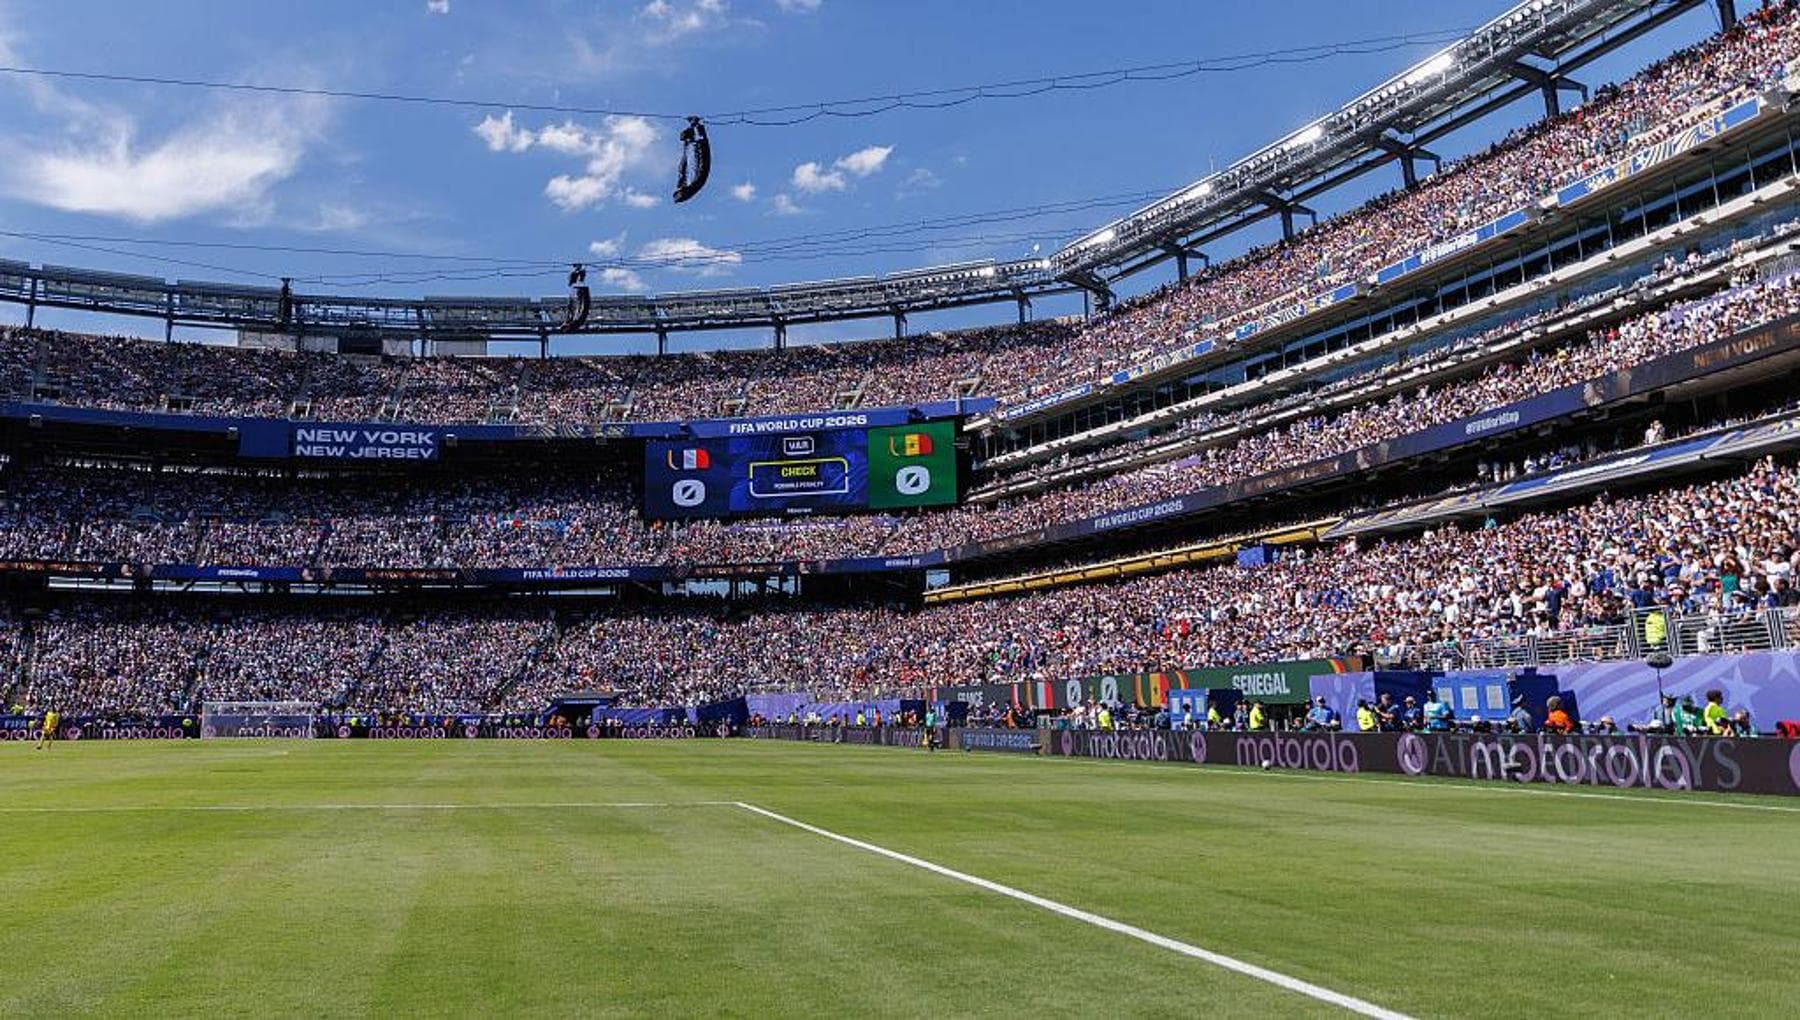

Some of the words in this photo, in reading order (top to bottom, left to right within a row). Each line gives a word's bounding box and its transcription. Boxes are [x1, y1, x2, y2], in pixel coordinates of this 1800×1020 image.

[730, 423, 754, 434] FIFA
[756, 419, 798, 432] WORLD
[800, 418, 823, 429] CUP
[825, 414, 867, 427] 2026
[296, 429, 357, 443] NEW
[363, 431, 433, 444] YORK
[296, 445, 345, 457] NEW
[350, 447, 433, 459] JERSEY
[789, 440, 809, 450] VAR
[781, 466, 817, 477] CHECK
[896, 466, 930, 495] 0
[672, 480, 705, 507] 0
[1155, 500, 1184, 516] 2026
[1233, 672, 1290, 696] SENEGAL
[103, 725, 184, 739] motorola
[369, 726, 446, 739] motorola
[497, 726, 572, 739] motorola
[1236, 732, 1359, 773] motorola
[1471, 733, 1692, 791] motorola
